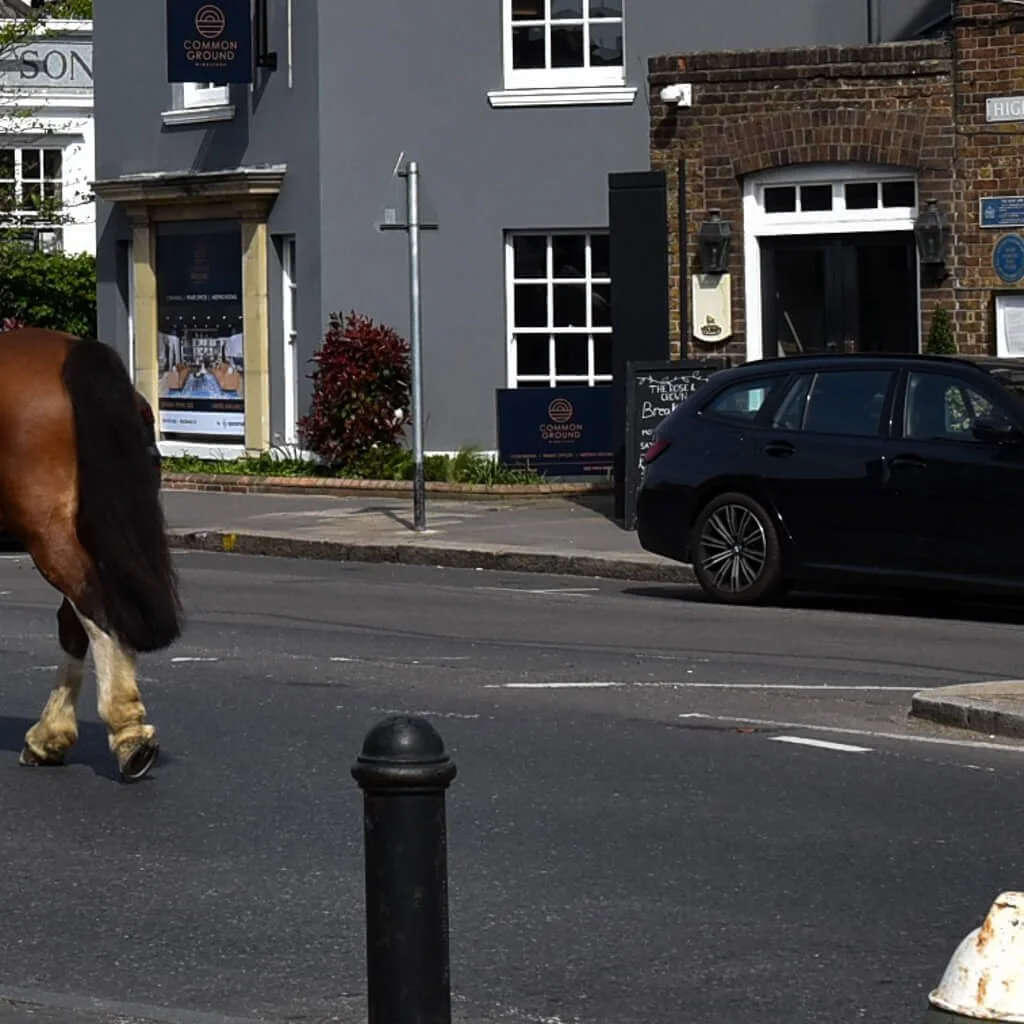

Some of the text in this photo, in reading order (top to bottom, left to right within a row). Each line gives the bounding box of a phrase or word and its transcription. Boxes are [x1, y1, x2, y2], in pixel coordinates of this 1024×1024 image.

[183, 40, 238, 50] COMMON
[186, 51, 235, 61] GROUND
[993, 100, 1024, 117] HIG
[539, 423, 584, 432] COMMON
[542, 431, 581, 440] GROUND
